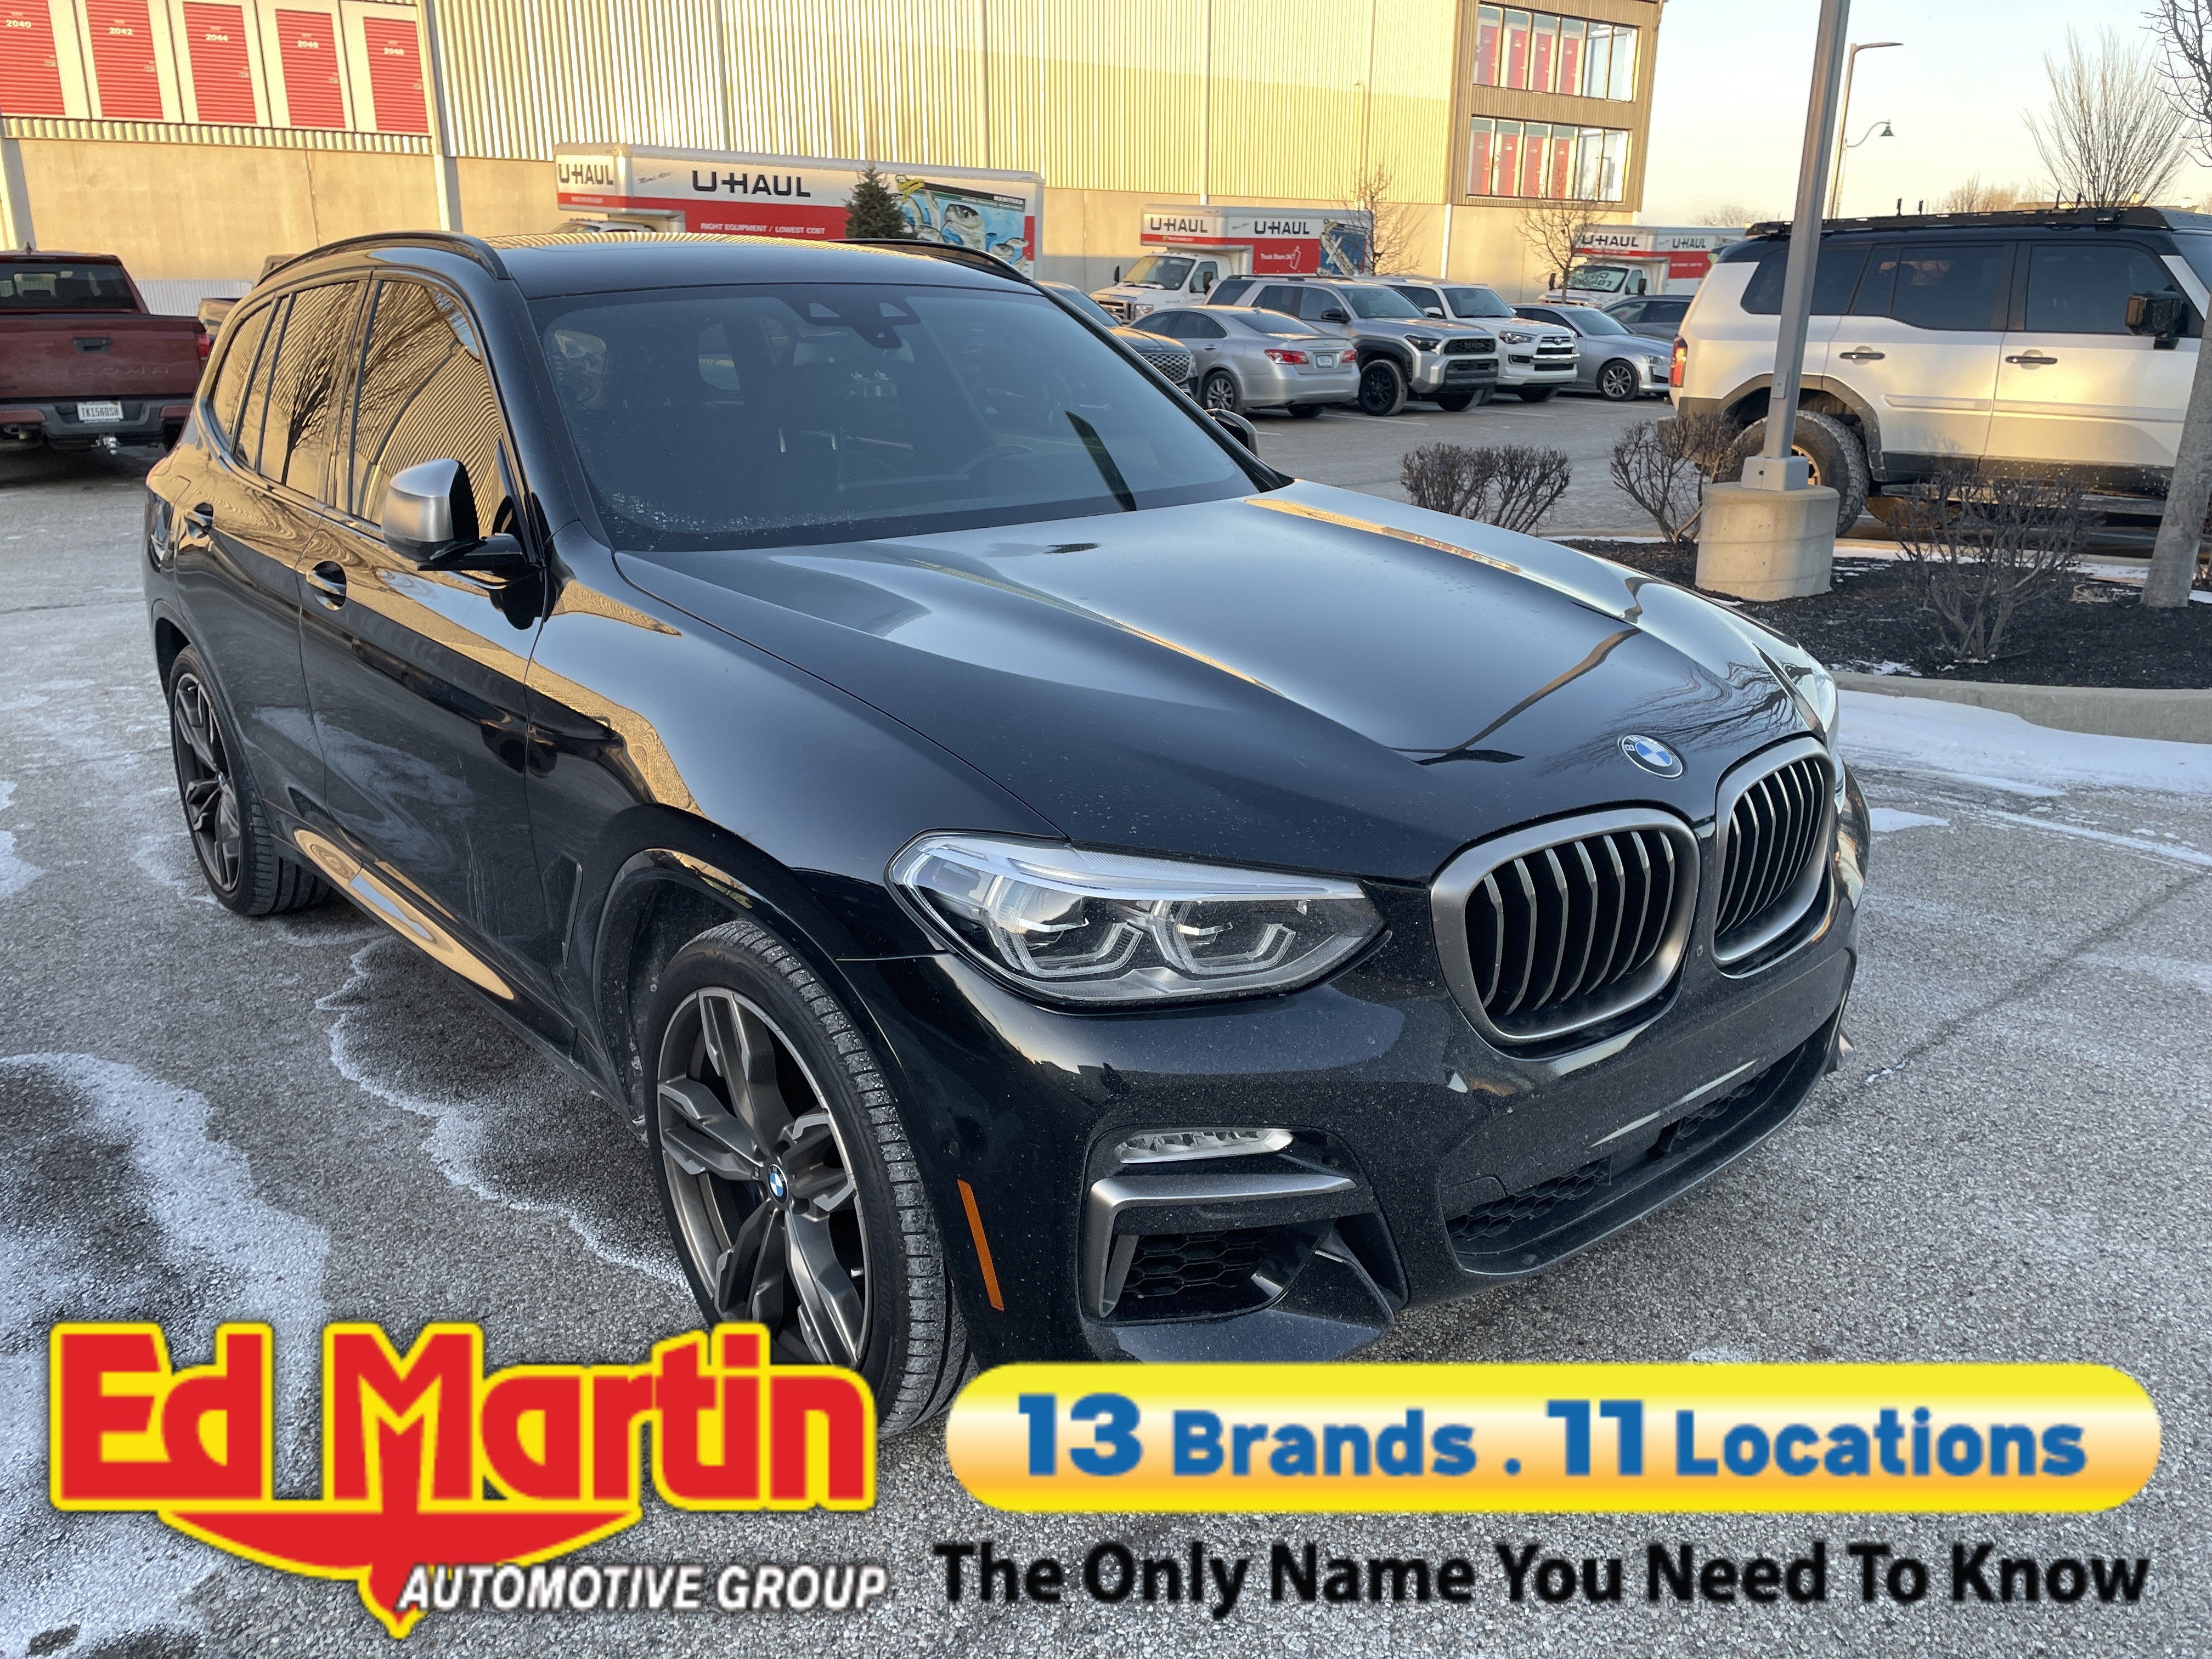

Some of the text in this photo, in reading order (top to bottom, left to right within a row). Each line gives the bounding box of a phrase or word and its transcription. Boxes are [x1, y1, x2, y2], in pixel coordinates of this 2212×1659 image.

[5, 19, 31, 28] 2040
[109, 27, 133, 35] 2042
[692, 170, 811, 198] U-HAUL
[724, 224, 768, 232] EQUIPMENT
[775, 225, 805, 234] LOWEST
